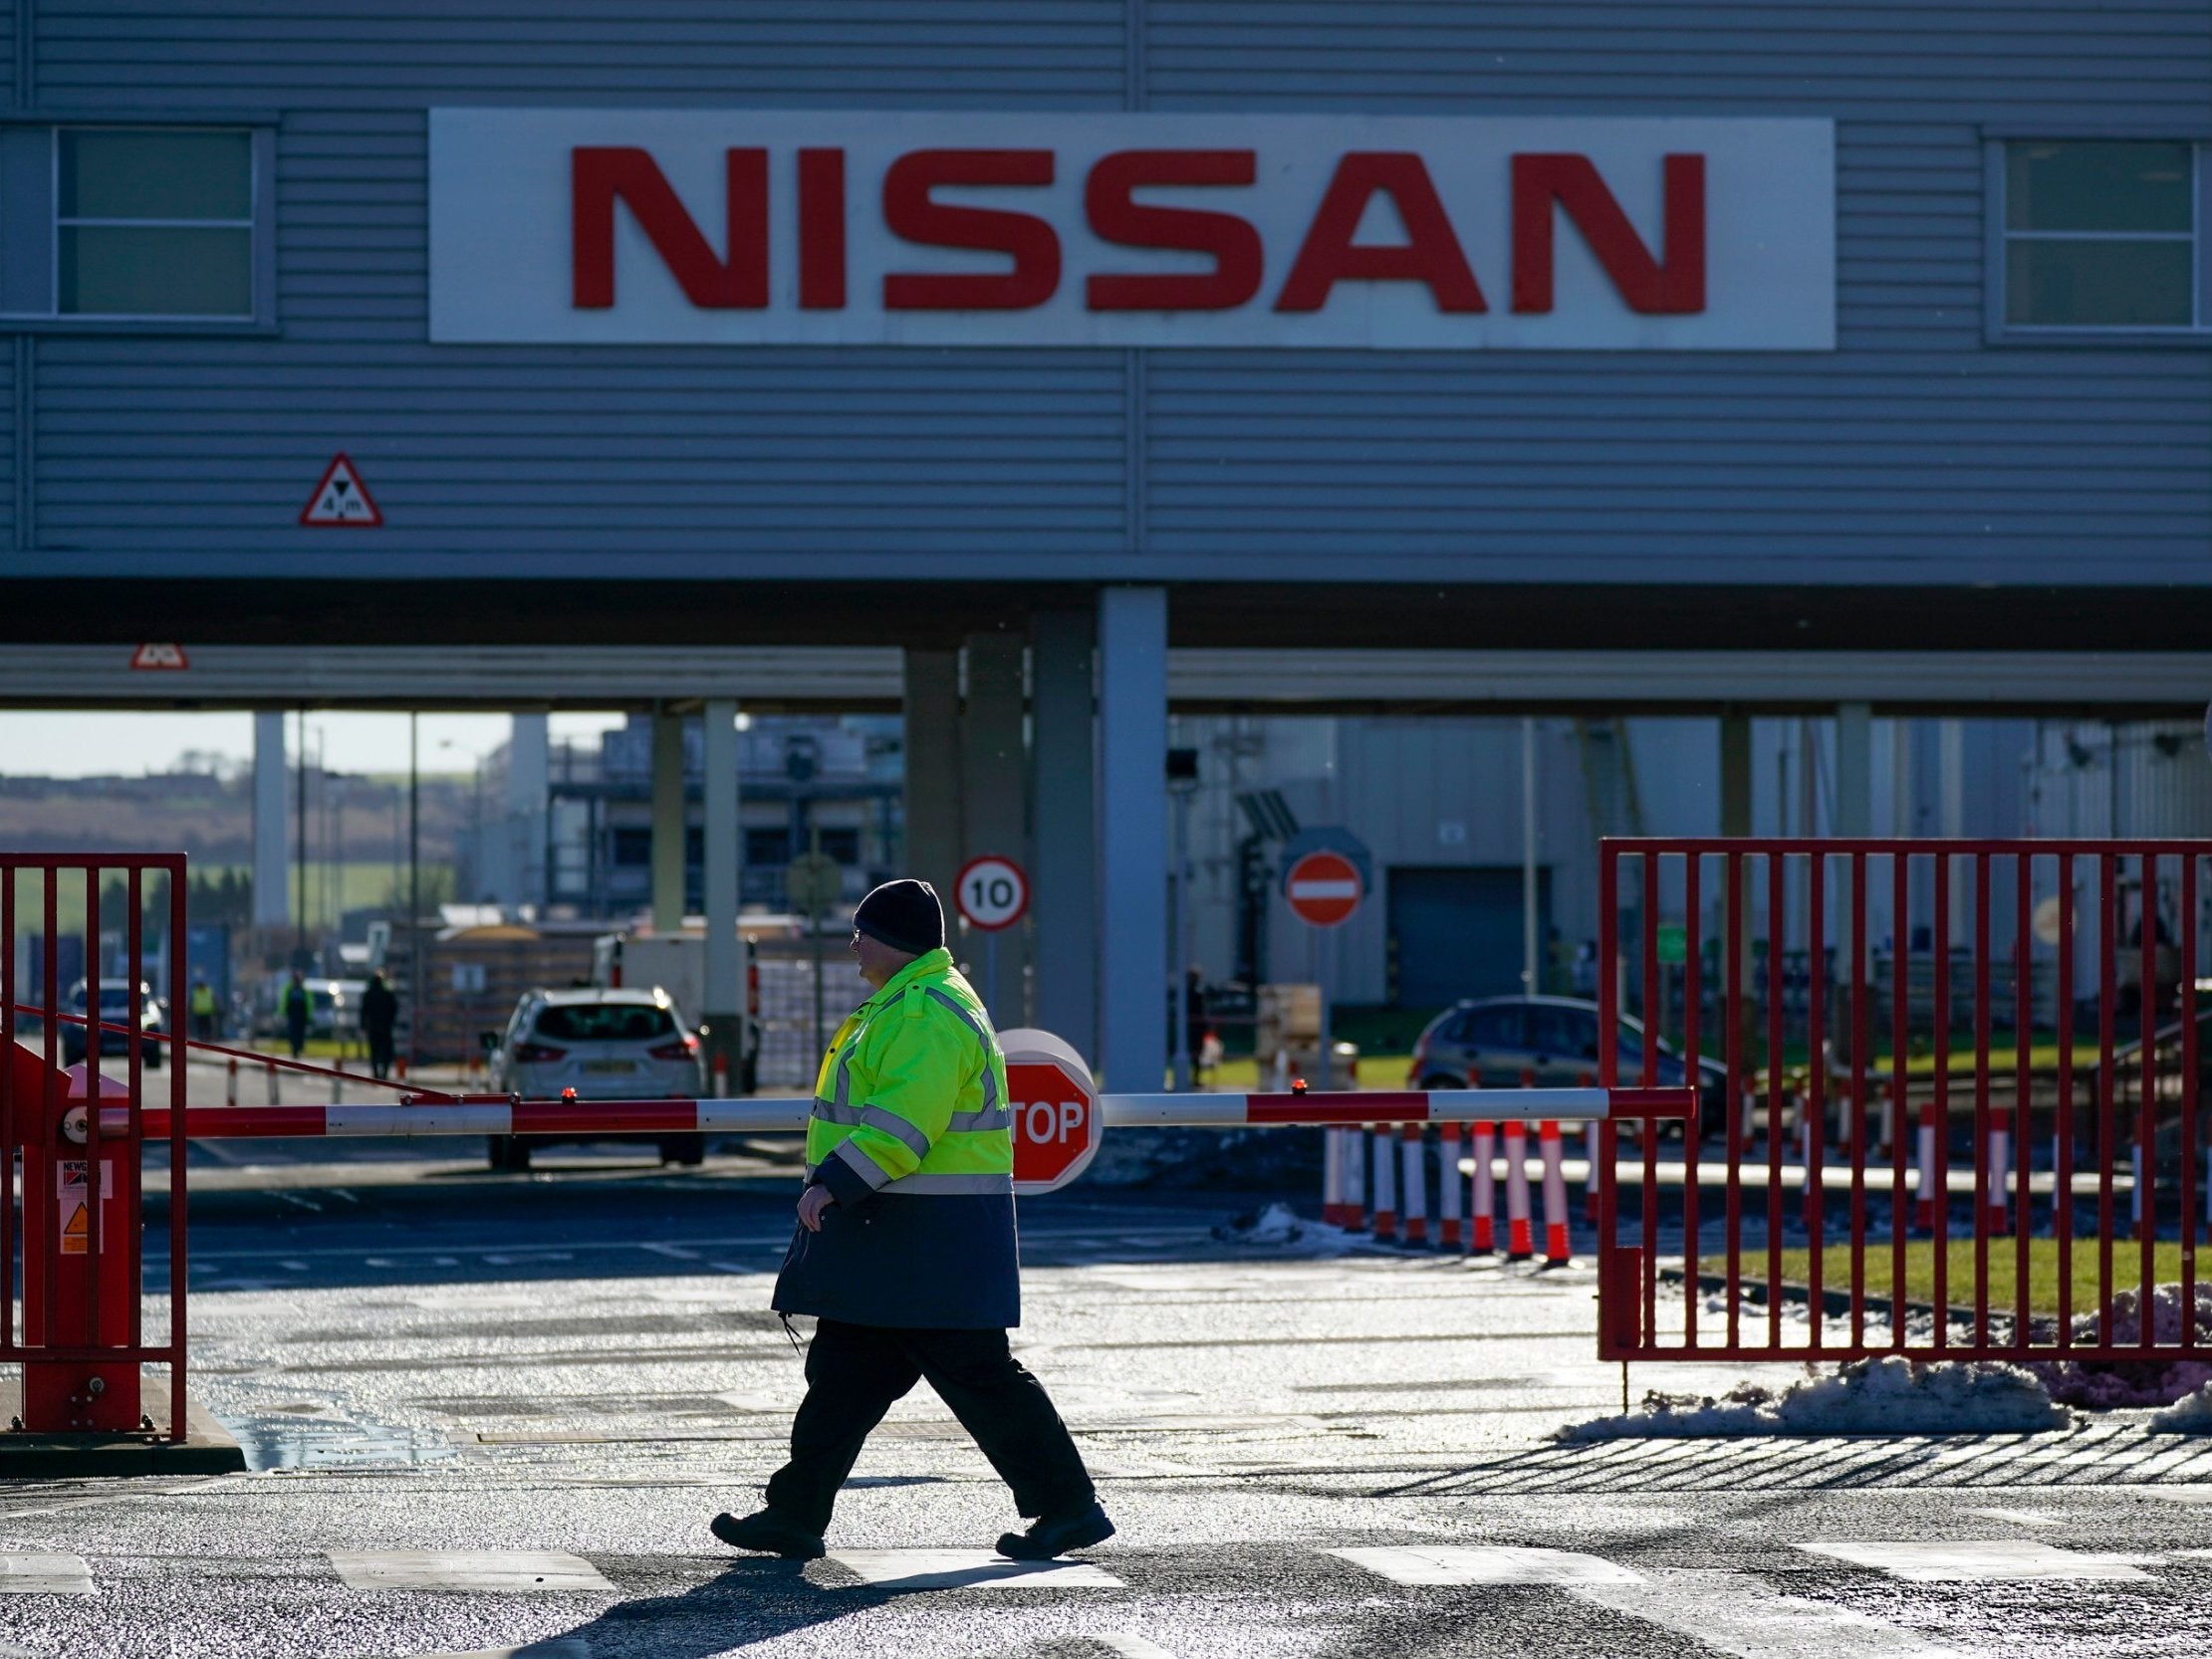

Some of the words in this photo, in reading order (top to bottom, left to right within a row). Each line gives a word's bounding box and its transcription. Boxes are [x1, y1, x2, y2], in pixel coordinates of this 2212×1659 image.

[572, 146, 1706, 315] NISSAN
[971, 878, 1014, 909] 10
[1008, 1100, 1085, 1144] TOP
